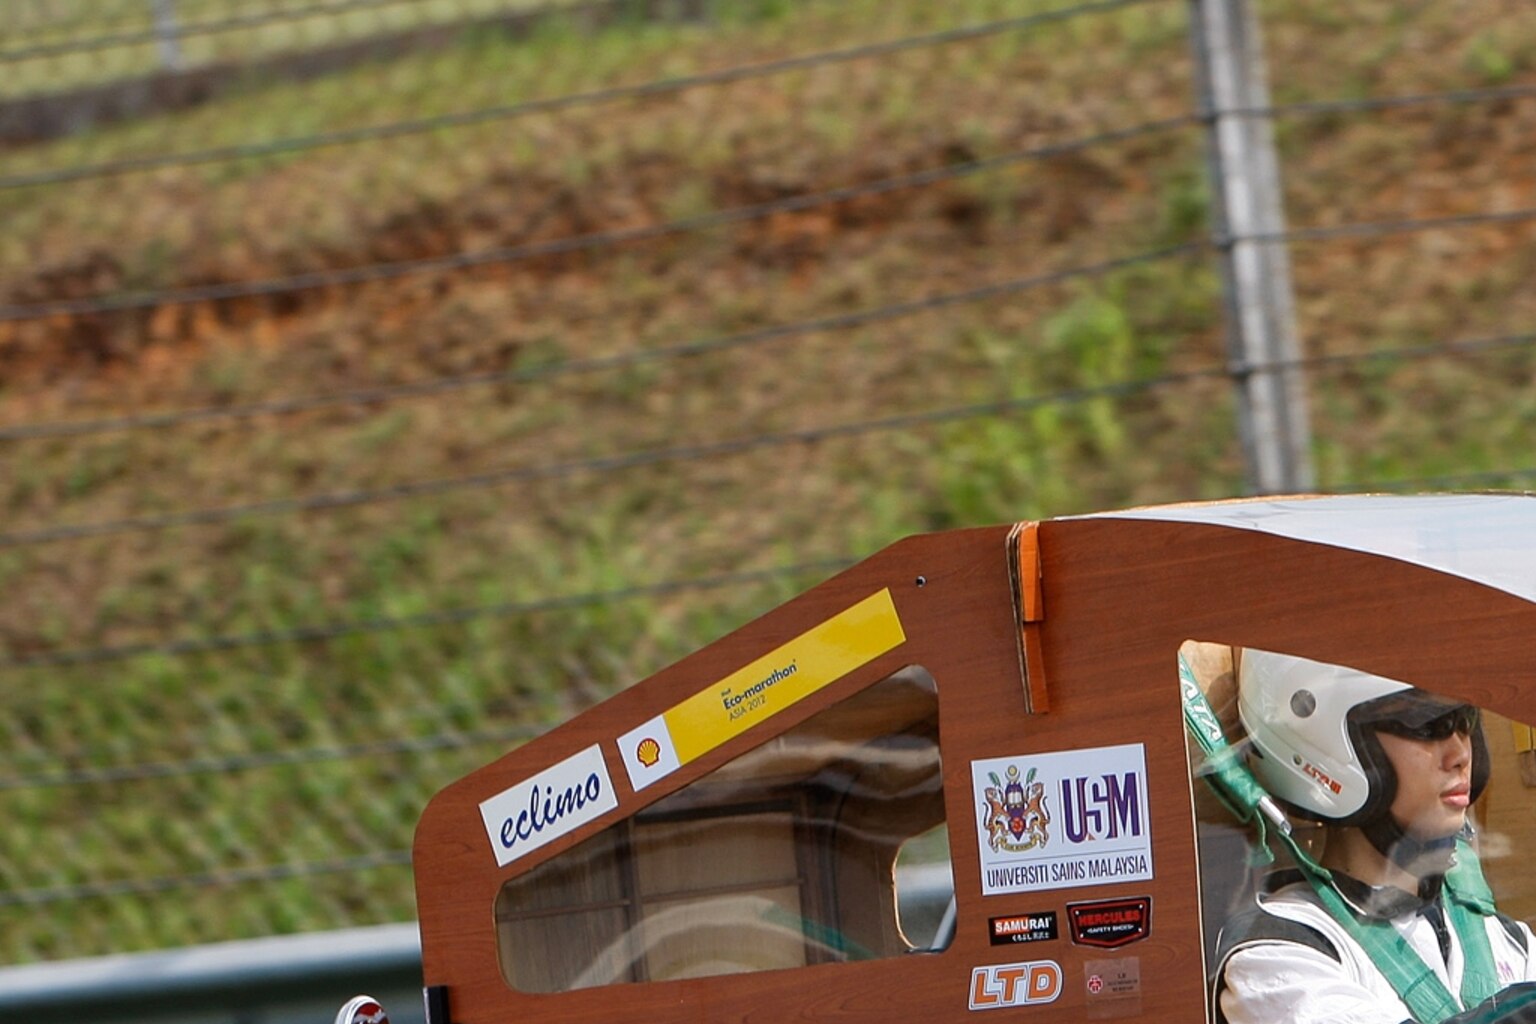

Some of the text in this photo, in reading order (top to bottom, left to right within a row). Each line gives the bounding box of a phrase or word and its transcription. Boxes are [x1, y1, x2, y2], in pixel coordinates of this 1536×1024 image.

[723, 663, 798, 710] Eco-marathon
[729, 694, 767, 722] ASIA 2012
[500, 773, 600, 848] eclimo
[1061, 772, 1141, 843] USM
[987, 855, 1148, 888] UNIVERSITI SAINS MALAYSIA
[995, 917, 1050, 933] SAMURAI
[1079, 910, 1140, 926] HERCULES
[974, 965, 1058, 1005] LTD
